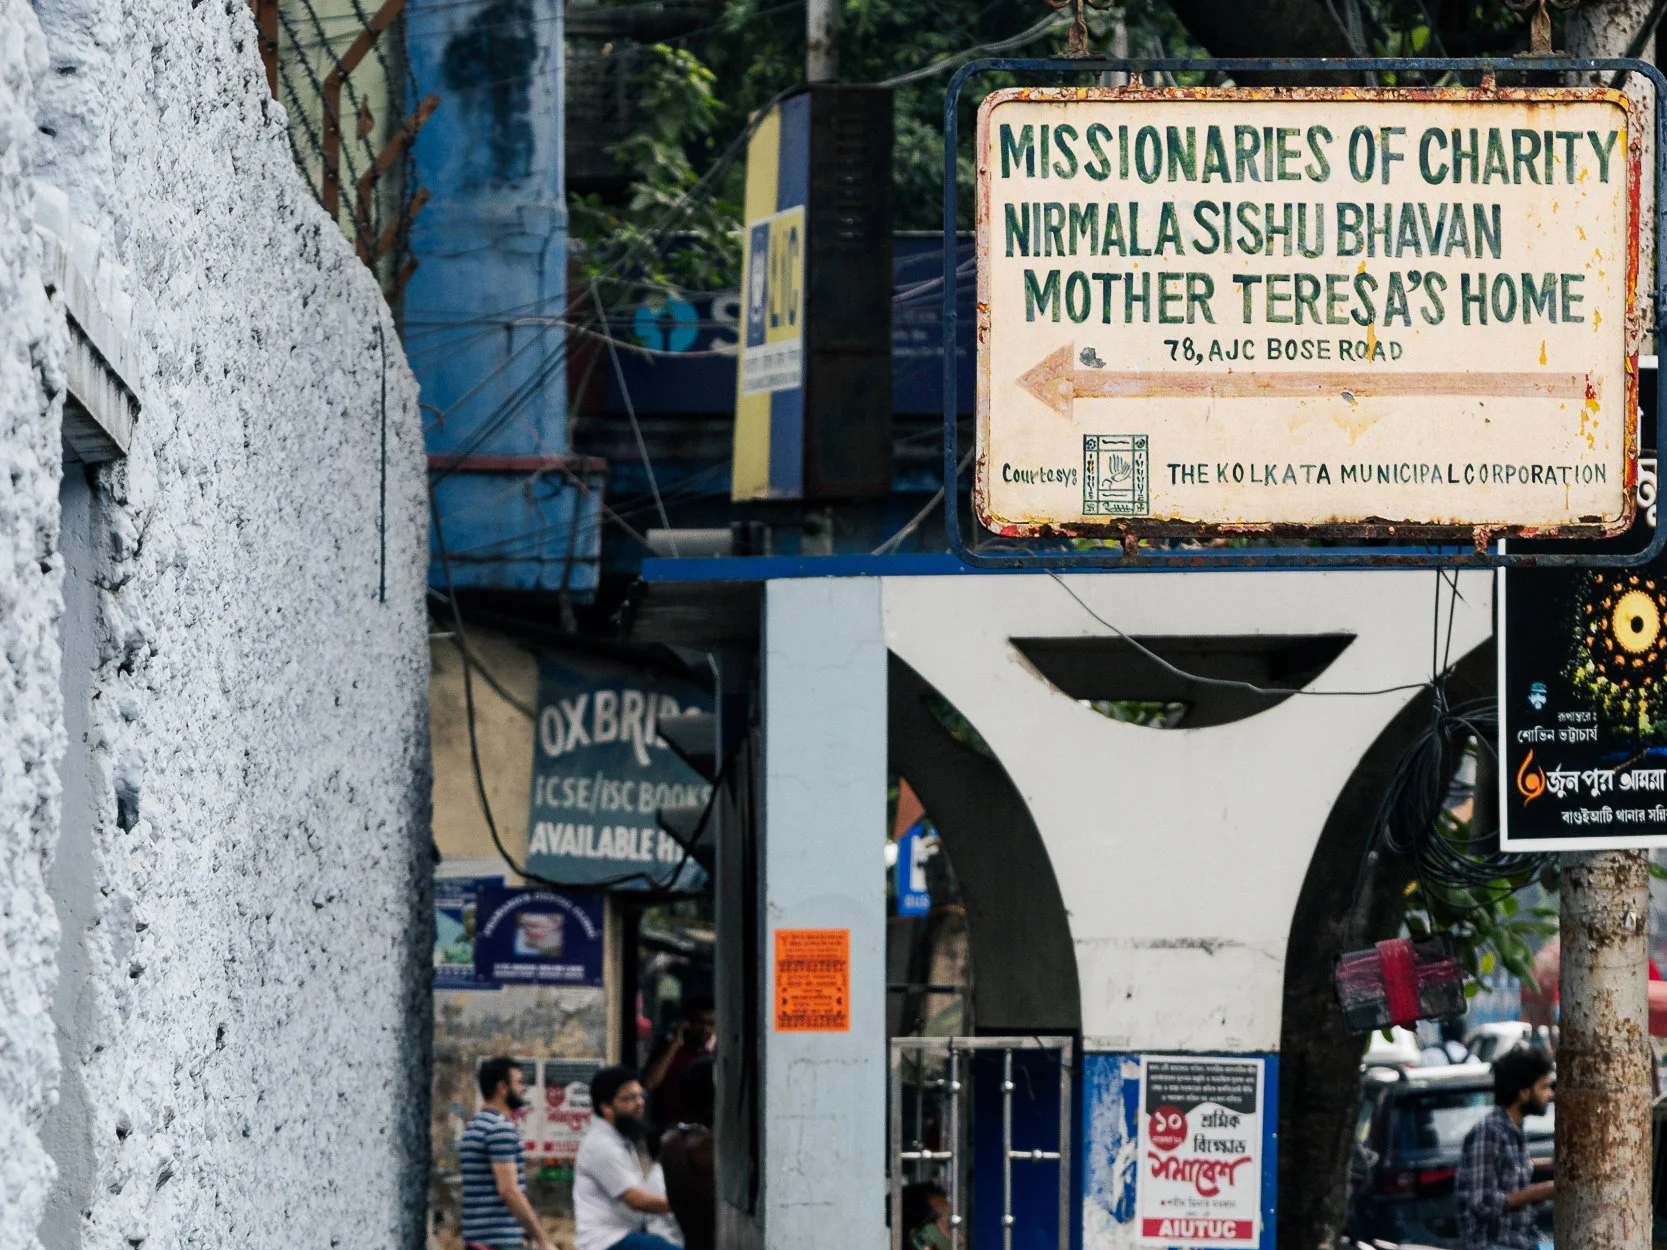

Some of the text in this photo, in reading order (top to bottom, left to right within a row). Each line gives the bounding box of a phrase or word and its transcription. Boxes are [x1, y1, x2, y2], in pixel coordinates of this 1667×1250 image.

[999, 122, 1619, 185] MISSIONARIES OF CHARITY
[1004, 199, 1502, 260] NIRMALA SISHU BHAVAN
[1023, 269, 1585, 327] MOTHER TERESA'S HOME
[1266, 337, 1332, 361] BOSE
[1338, 338, 1404, 362] ROAD
[1166, 461, 1607, 487] THE KOLKATA MUNICIPAL CORPORATION
[528, 821, 655, 861] AVAILABLE
[1154, 1111, 1183, 1133] ১০
[1158, 1219, 1238, 1238] AIUTUC
